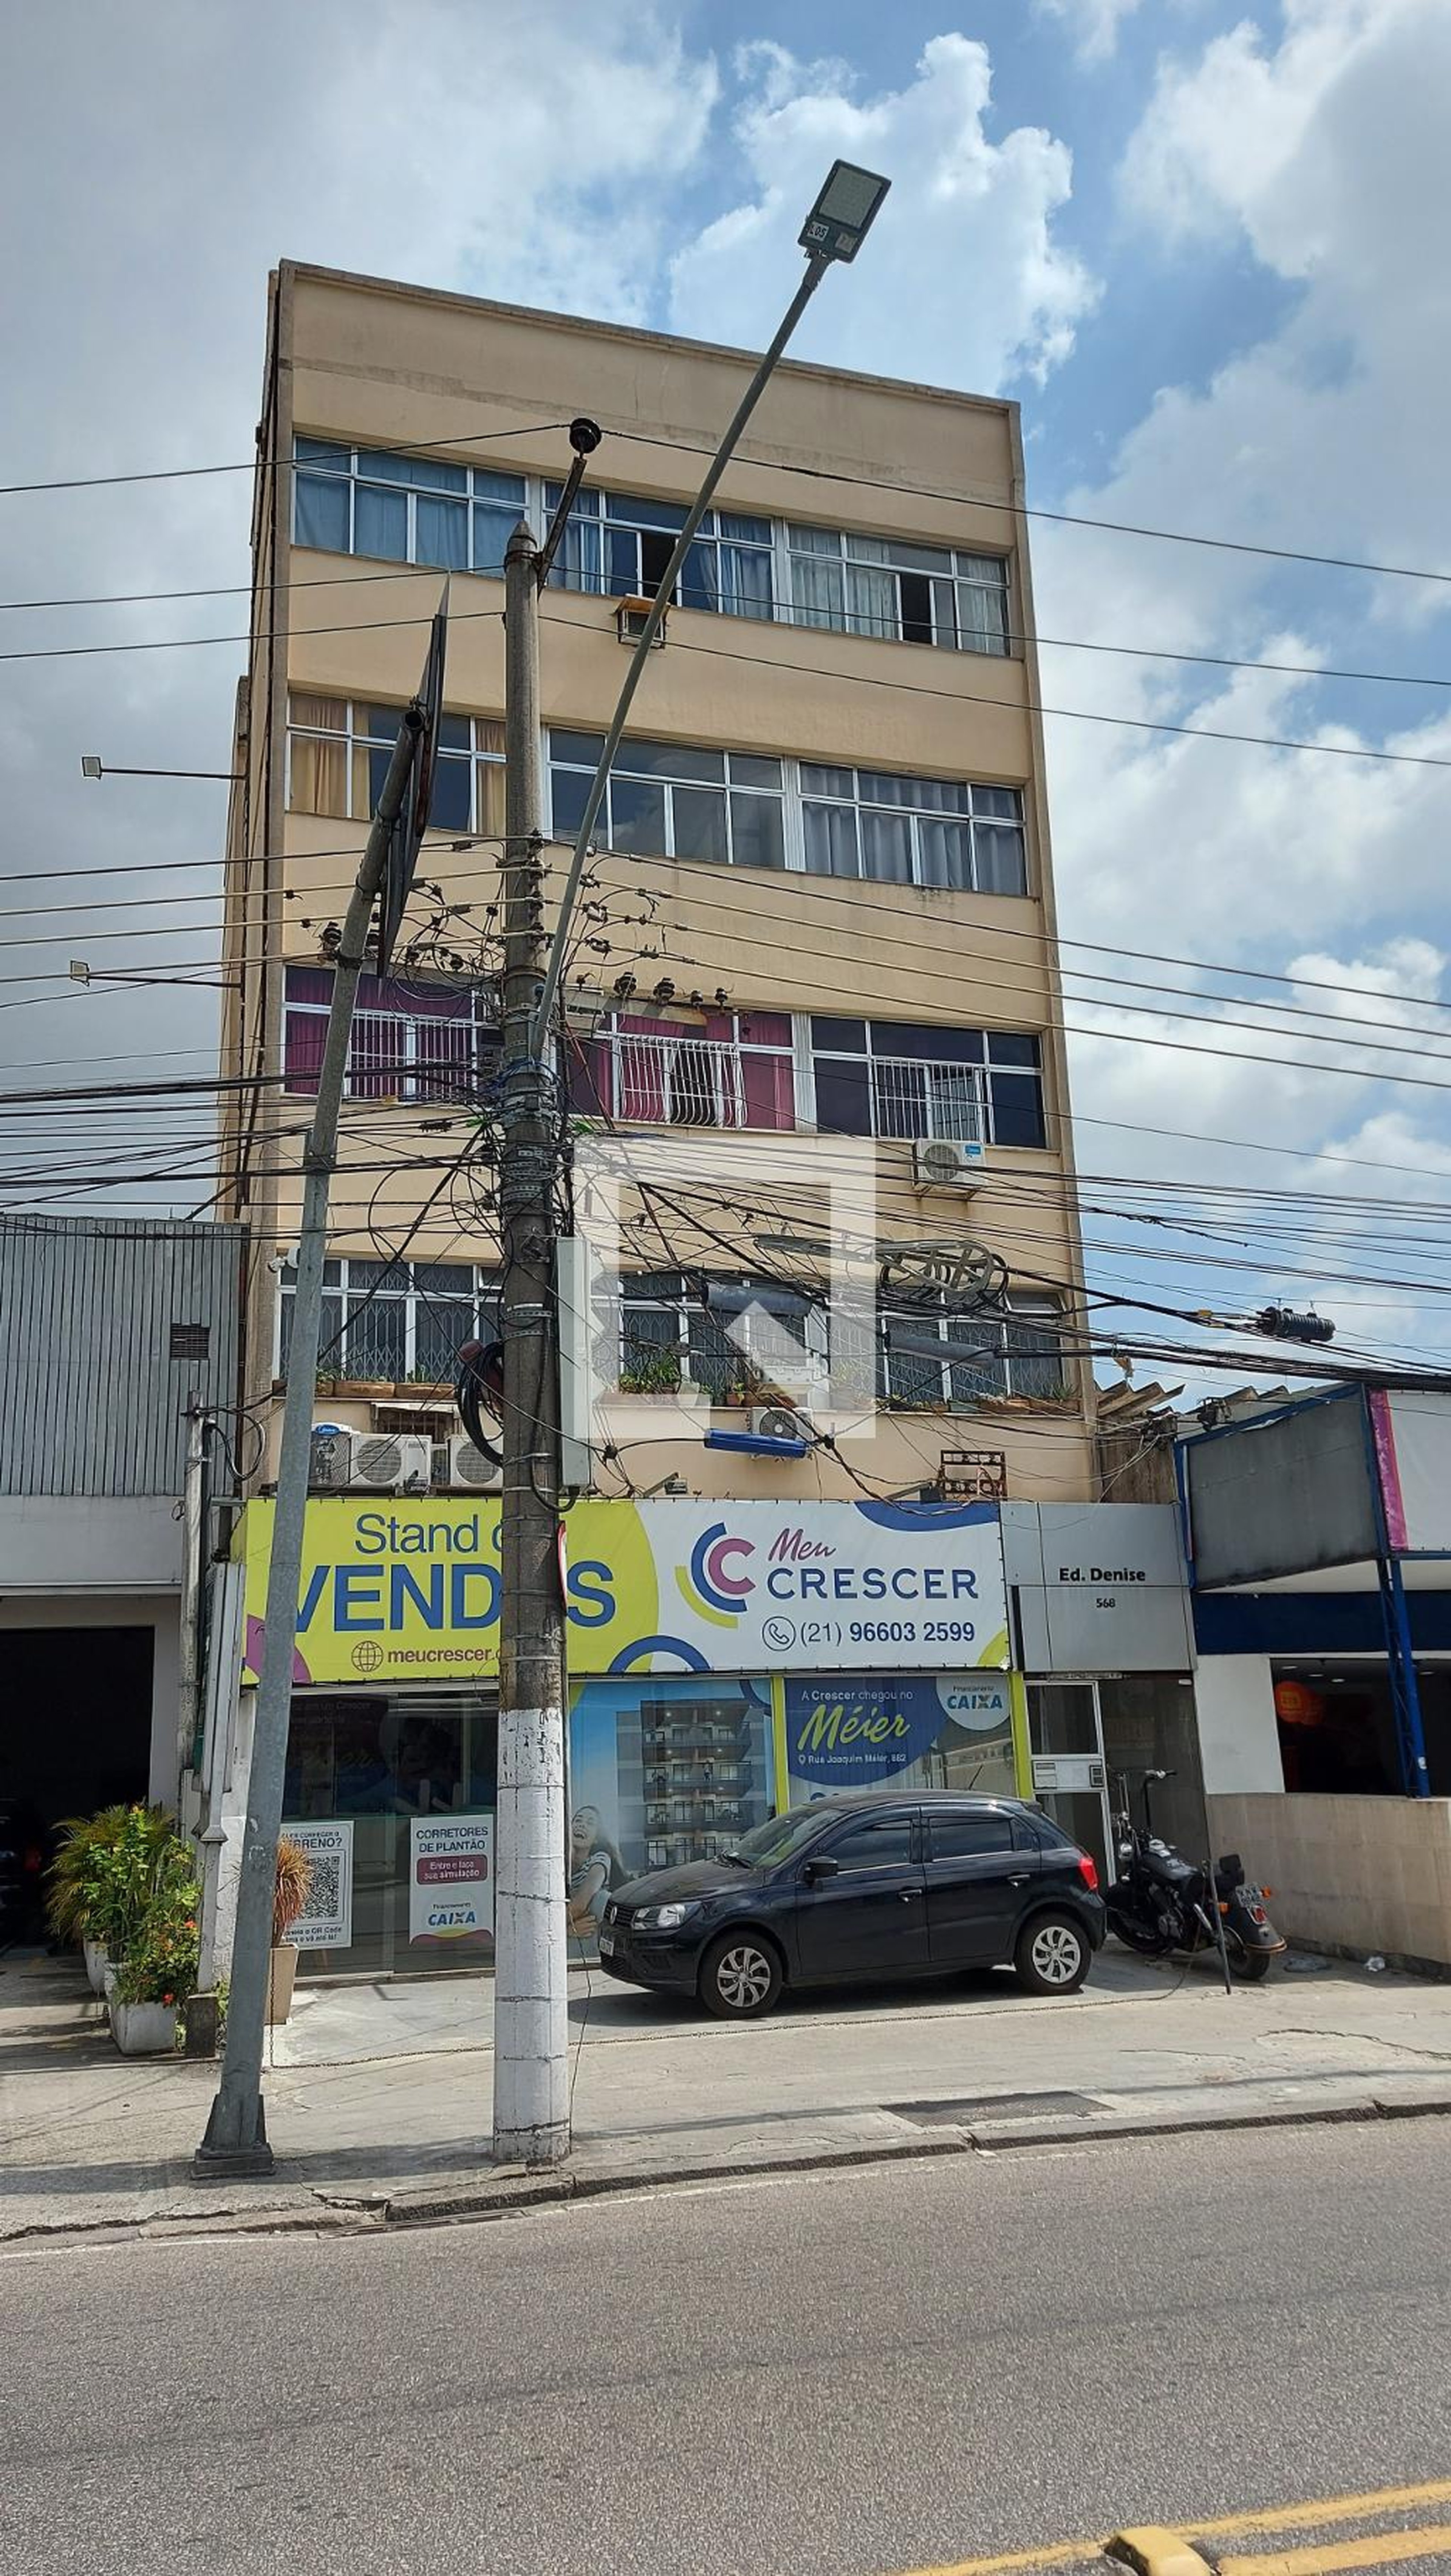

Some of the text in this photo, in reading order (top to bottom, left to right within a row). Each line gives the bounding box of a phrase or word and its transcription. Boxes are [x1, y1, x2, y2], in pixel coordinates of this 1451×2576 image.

[355, 1514, 478, 1554] Stand
[768, 1528, 836, 1561] Meu
[1060, 1568, 1146, 1582] Ed. Denise
[767, 1568, 979, 1599] CRESCER
[297, 1560, 616, 1633] VENDS
[1097, 1598, 1116, 1608] 568
[801, 1622, 975, 1647] (21) 96603 2599
[801, 1690, 913, 1702] A Crescer chegou no
[947, 1695, 1002, 1709] CAIXA
[797, 1704, 911, 1751] Méier
[416, 1826, 488, 1839] CORRETORES
[420, 1839, 485, 1852] DE PLANTÃO
[428, 1911, 475, 1925] CAIXA
